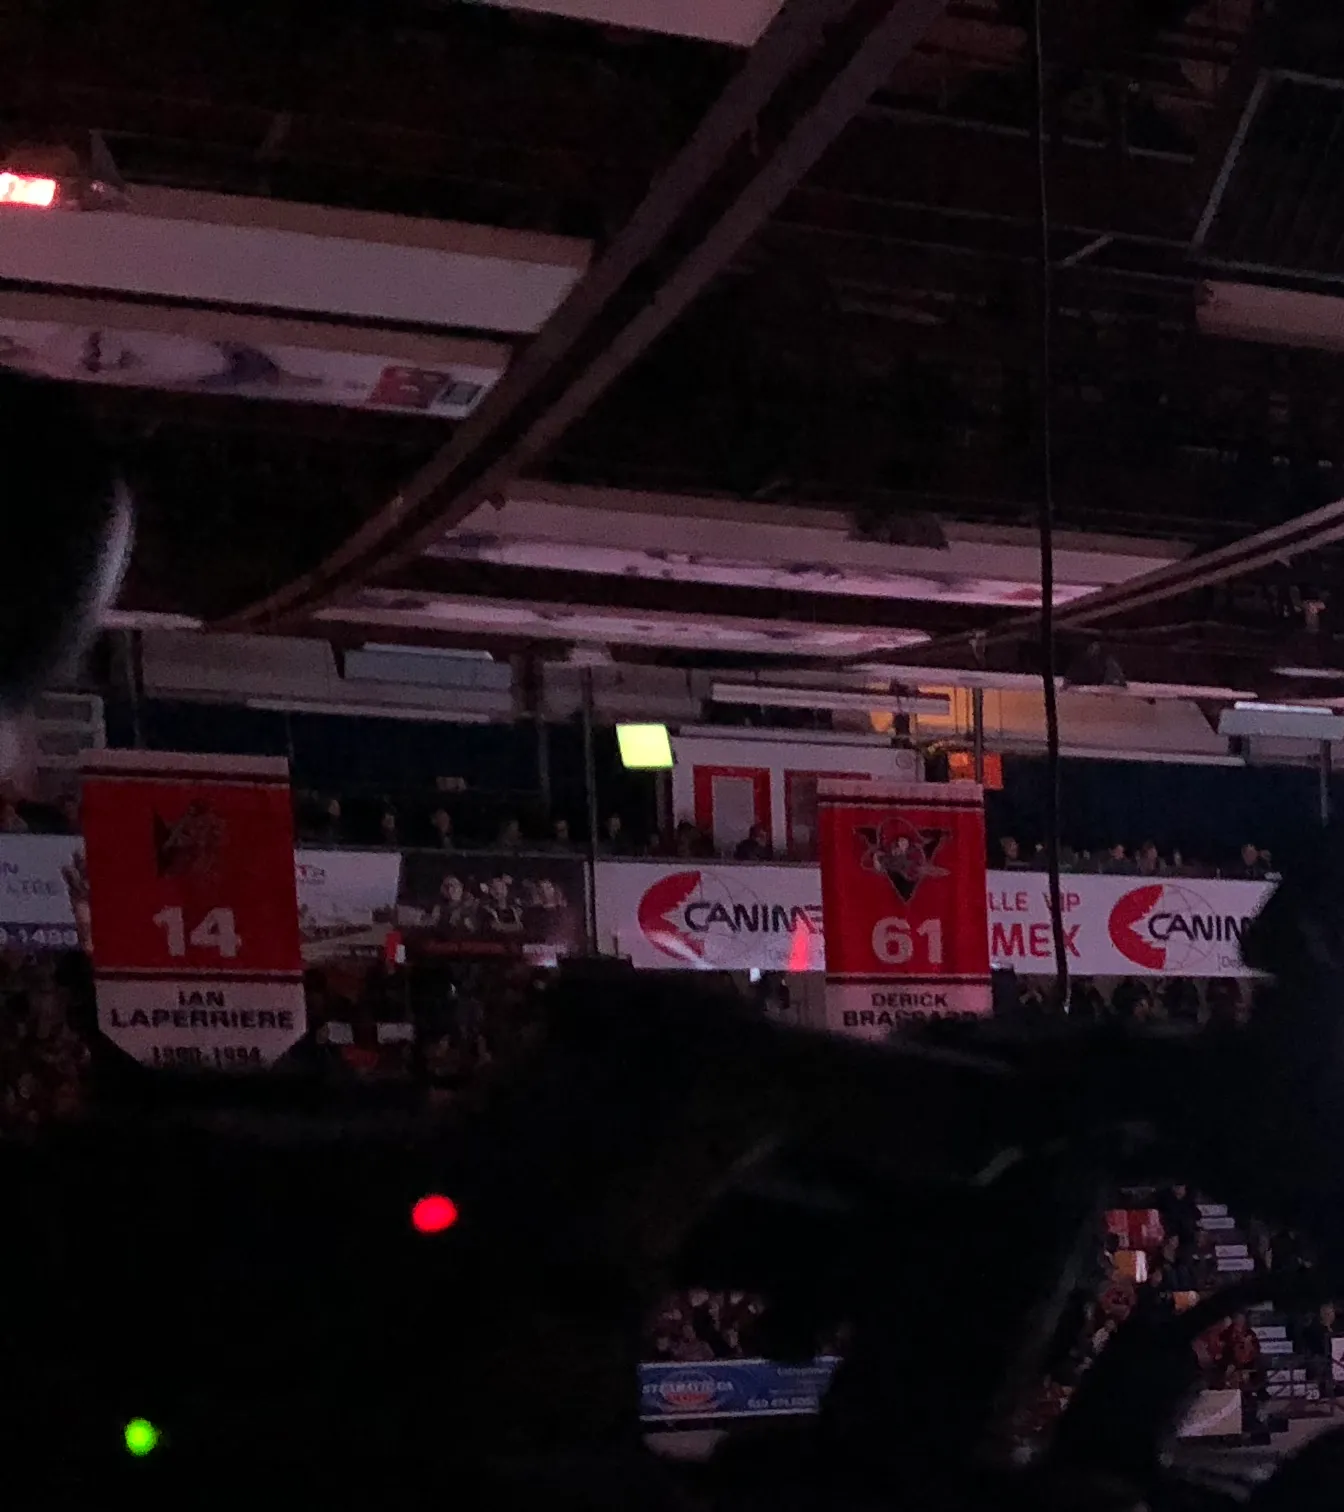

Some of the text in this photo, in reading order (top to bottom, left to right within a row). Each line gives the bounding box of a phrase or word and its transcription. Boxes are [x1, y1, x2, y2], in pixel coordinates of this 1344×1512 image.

[152, 904, 242, 959] 14
[870, 916, 944, 965] 61
[178, 989, 225, 1007] IAN
[871, 992, 948, 1008] DERICK
[110, 1009, 294, 1030] LAPERRIERE
